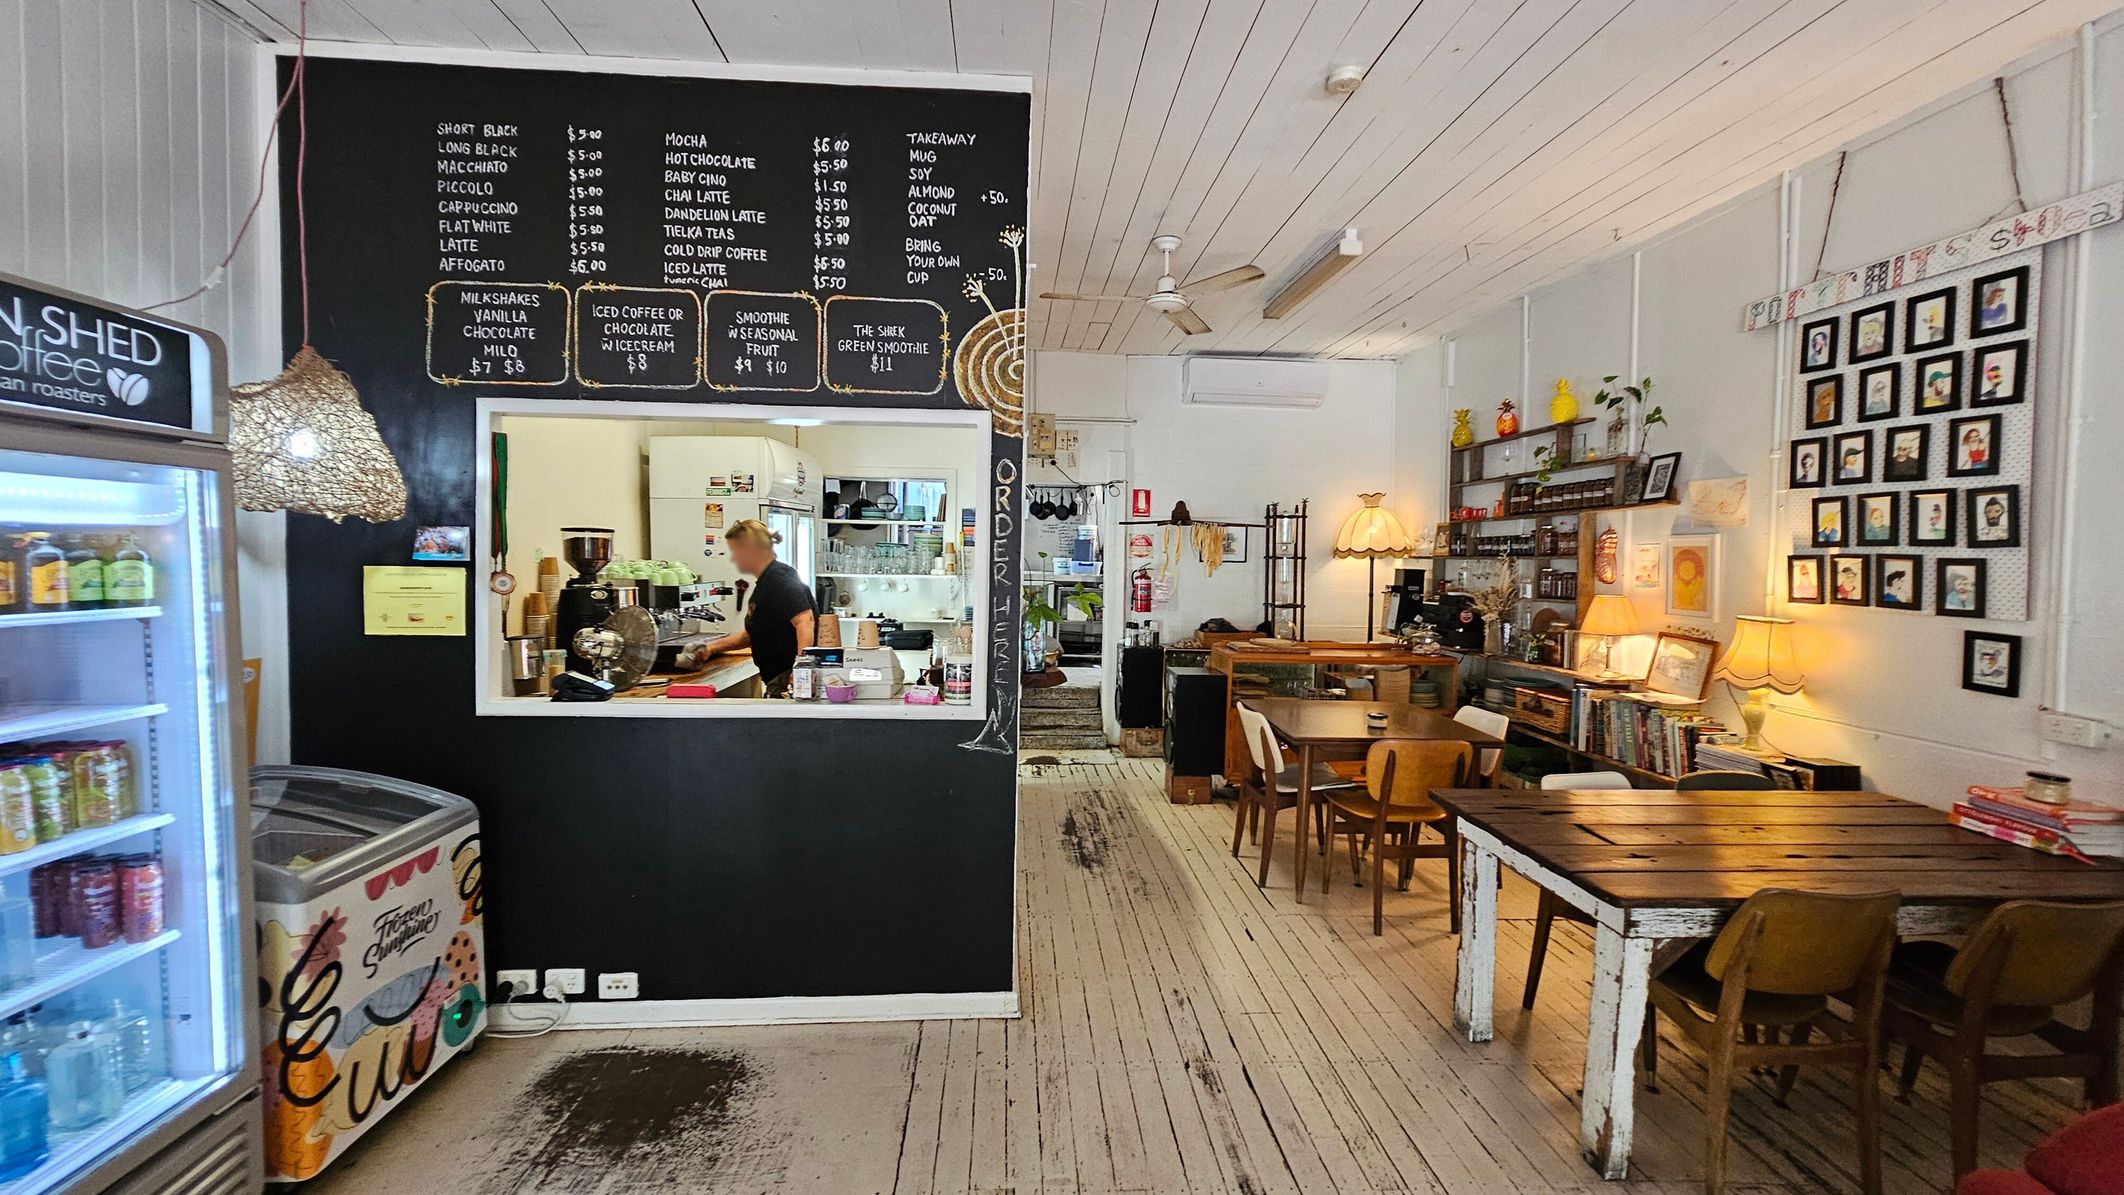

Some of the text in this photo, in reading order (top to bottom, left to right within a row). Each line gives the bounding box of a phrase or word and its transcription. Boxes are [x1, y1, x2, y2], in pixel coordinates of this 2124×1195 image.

[436, 122, 518, 138] SHORT BLACK
[665, 132, 708, 149] MOCHA
[905, 131, 977, 146] TAKEAWAY
[438, 141, 518, 158] LONG BLACK
[909, 148, 937, 163] MUG
[437, 159, 508, 175] MACCHIATO
[689, 152, 757, 170] CHOCOLATE
[664, 169, 727, 187] BABY CINO
[908, 166, 933, 181] SOY
[437, 179, 494, 196] PICCOLO
[908, 184, 956, 200] ALMOND
[664, 188, 731, 205] CHAI LATTE
[438, 200, 518, 215] CAPPUCCINO
[664, 206, 767, 225] DANDELION LATTE
[907, 201, 958, 217] COCONUT
[909, 214, 938, 228] OAT
[663, 224, 736, 241] TIELKA TEAS
[439, 237, 479, 253] LATTE
[663, 243, 768, 262] COLD DRIP COFFEE
[905, 237, 942, 253] BRING
[439, 257, 506, 273] AFFOGATO
[663, 261, 728, 276] ICED LATTE
[905, 254, 960, 269] YOUR OWN
[700, 276, 729, 290] CHAI
[906, 270, 930, 285] CUP
[460, 291, 541, 308] MILKSHAKES
[473, 308, 528, 324] VANILLA
[592, 303, 684, 321] ICED COFFEE OR
[735, 310, 790, 325] SMOOTHIE
[41, 305, 162, 366] SHED
[462, 324, 536, 340] CHOCOLATE
[604, 322, 675, 338] CHOCOLATE
[739, 326, 799, 342] SEASONAL
[852, 324, 906, 339] THE SHREK
[483, 344, 518, 358] MILO
[615, 339, 676, 354] ICECREAM
[745, 342, 780, 357] FRUIT
[837, 339, 930, 357] GREEN SMOOTHIE
[32, 382, 107, 407] roasters
[992, 457, 1017, 684] ORDER HERE
[373, 898, 433, 946] Frozen
[362, 909, 442, 979] Sunshine
